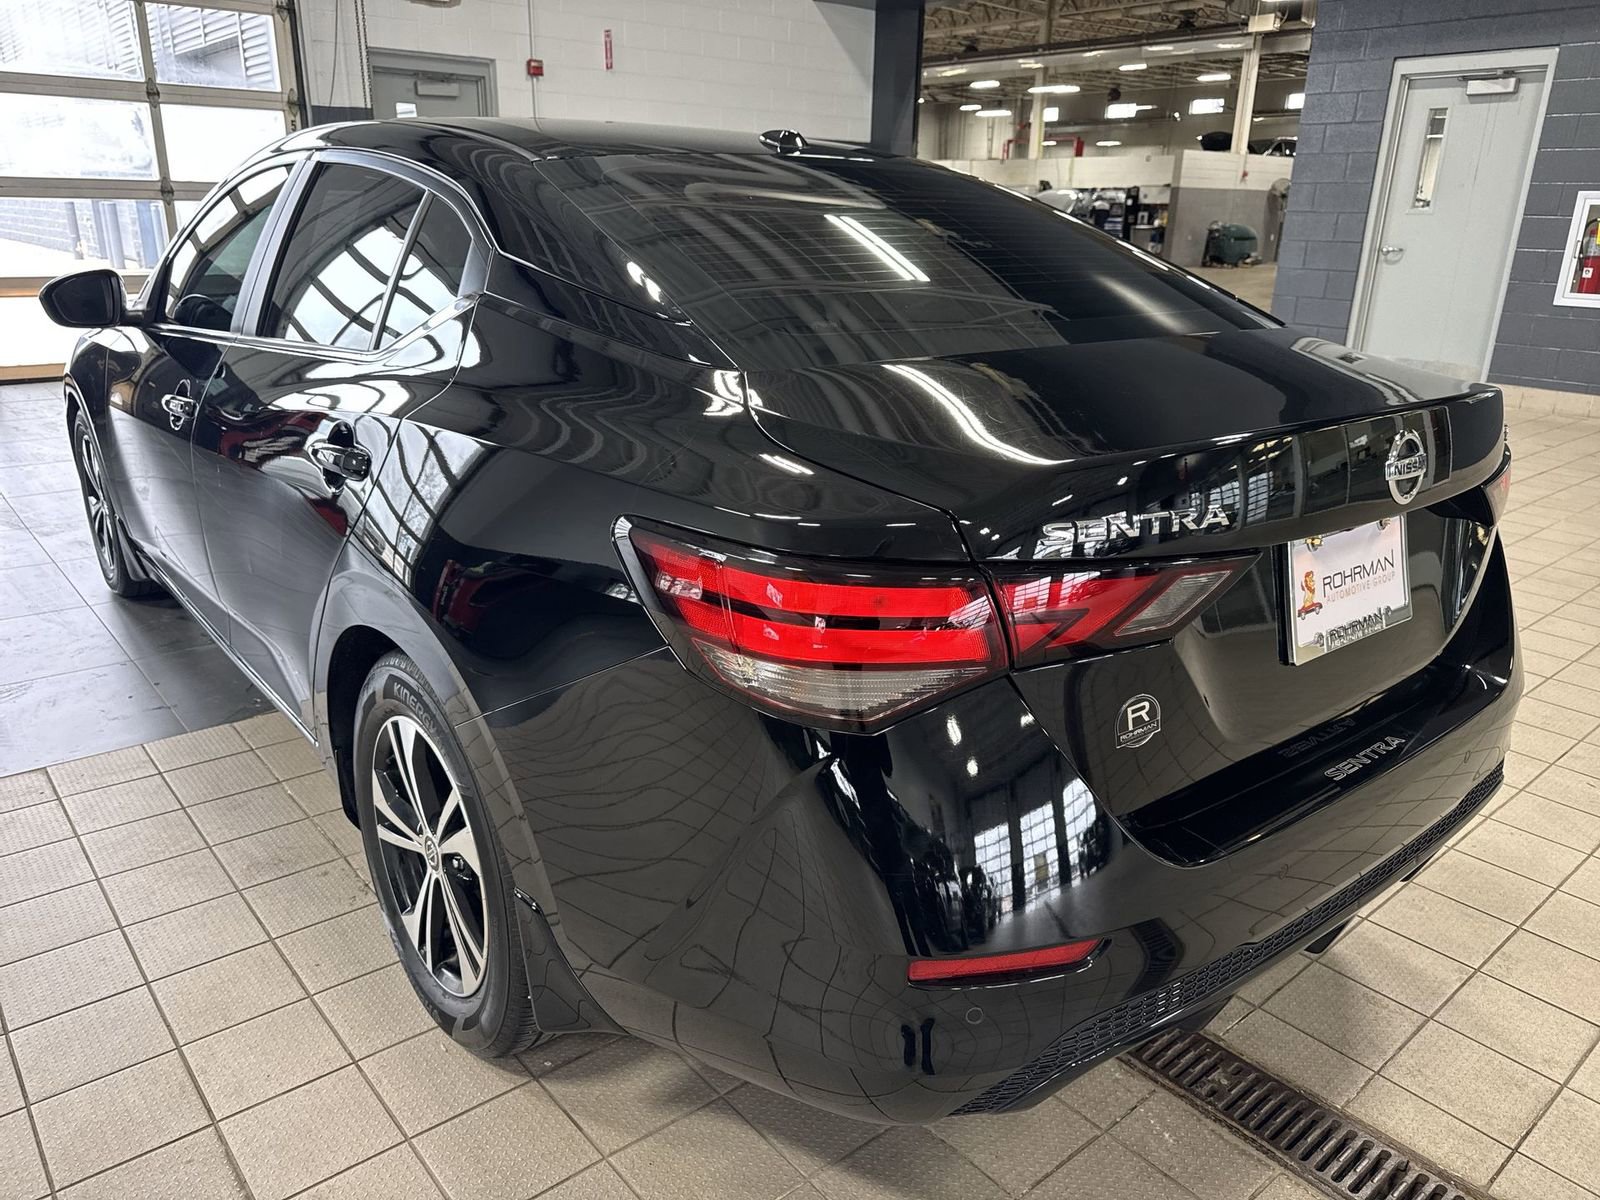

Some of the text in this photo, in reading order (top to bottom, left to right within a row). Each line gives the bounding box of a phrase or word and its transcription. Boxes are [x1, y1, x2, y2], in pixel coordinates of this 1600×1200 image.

[1042, 504, 1230, 547] SENTRA
[1322, 549, 1395, 598] ROHRMAN
[1326, 571, 1396, 603] AUTOMOTIVE GROUP
[1329, 607, 1383, 646] ROHRMAN
[1120, 721, 1157, 742] ROHRMAN
[1127, 701, 1150, 731] R
[1324, 736, 1406, 781] SENTRA
